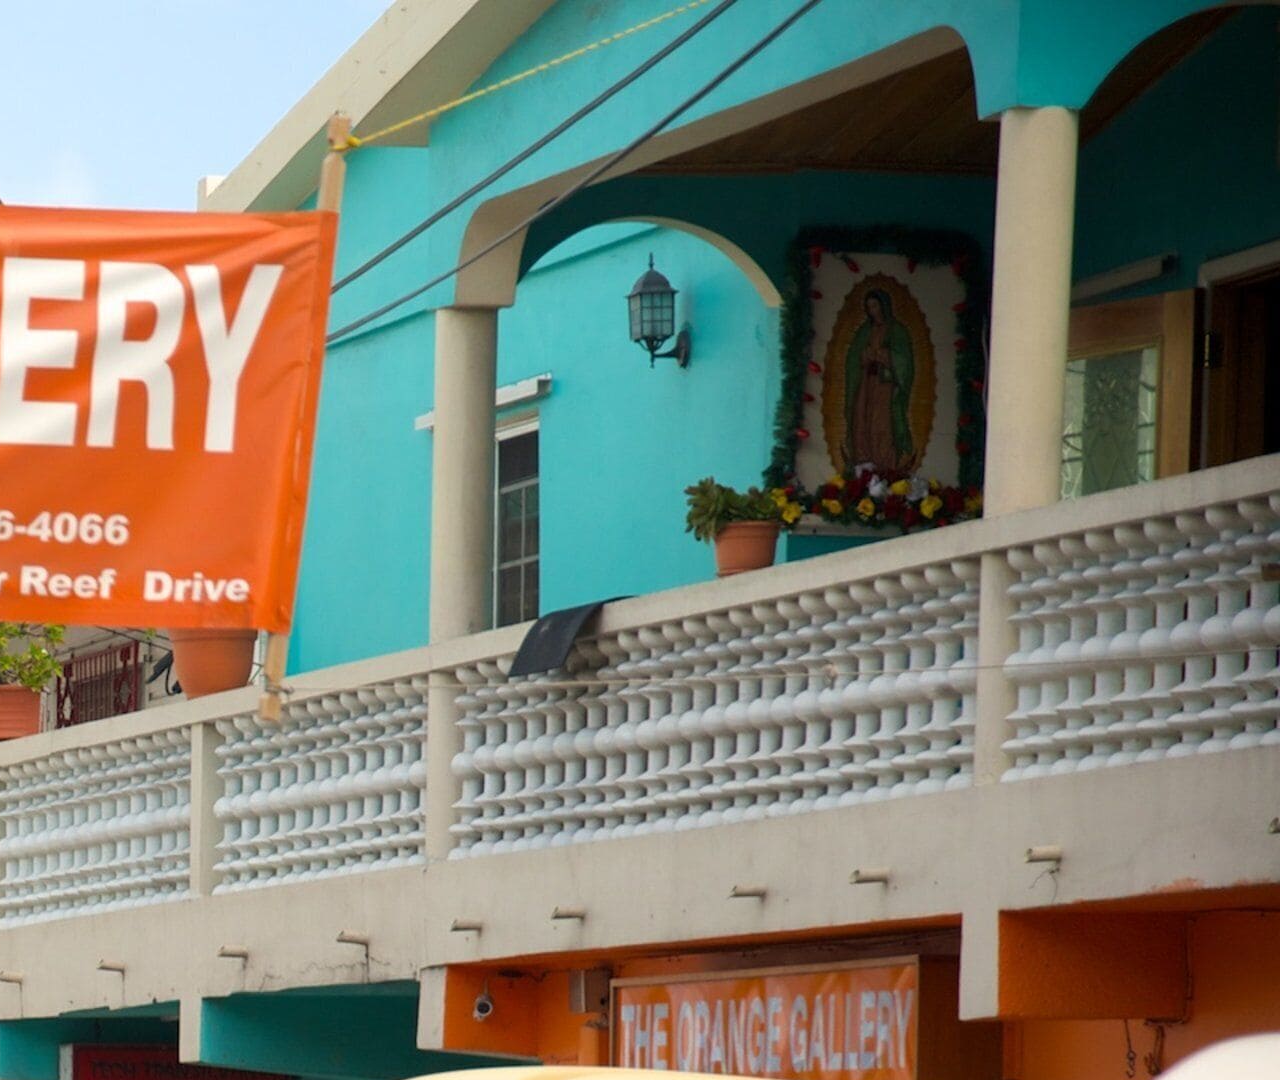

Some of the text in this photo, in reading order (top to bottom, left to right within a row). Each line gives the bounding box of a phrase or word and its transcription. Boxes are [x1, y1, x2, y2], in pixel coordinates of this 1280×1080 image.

[19, 565, 117, 600] Reef
[143, 569, 250, 603] Drive
[620, 988, 915, 1074] THE ORANGE GALLERY
